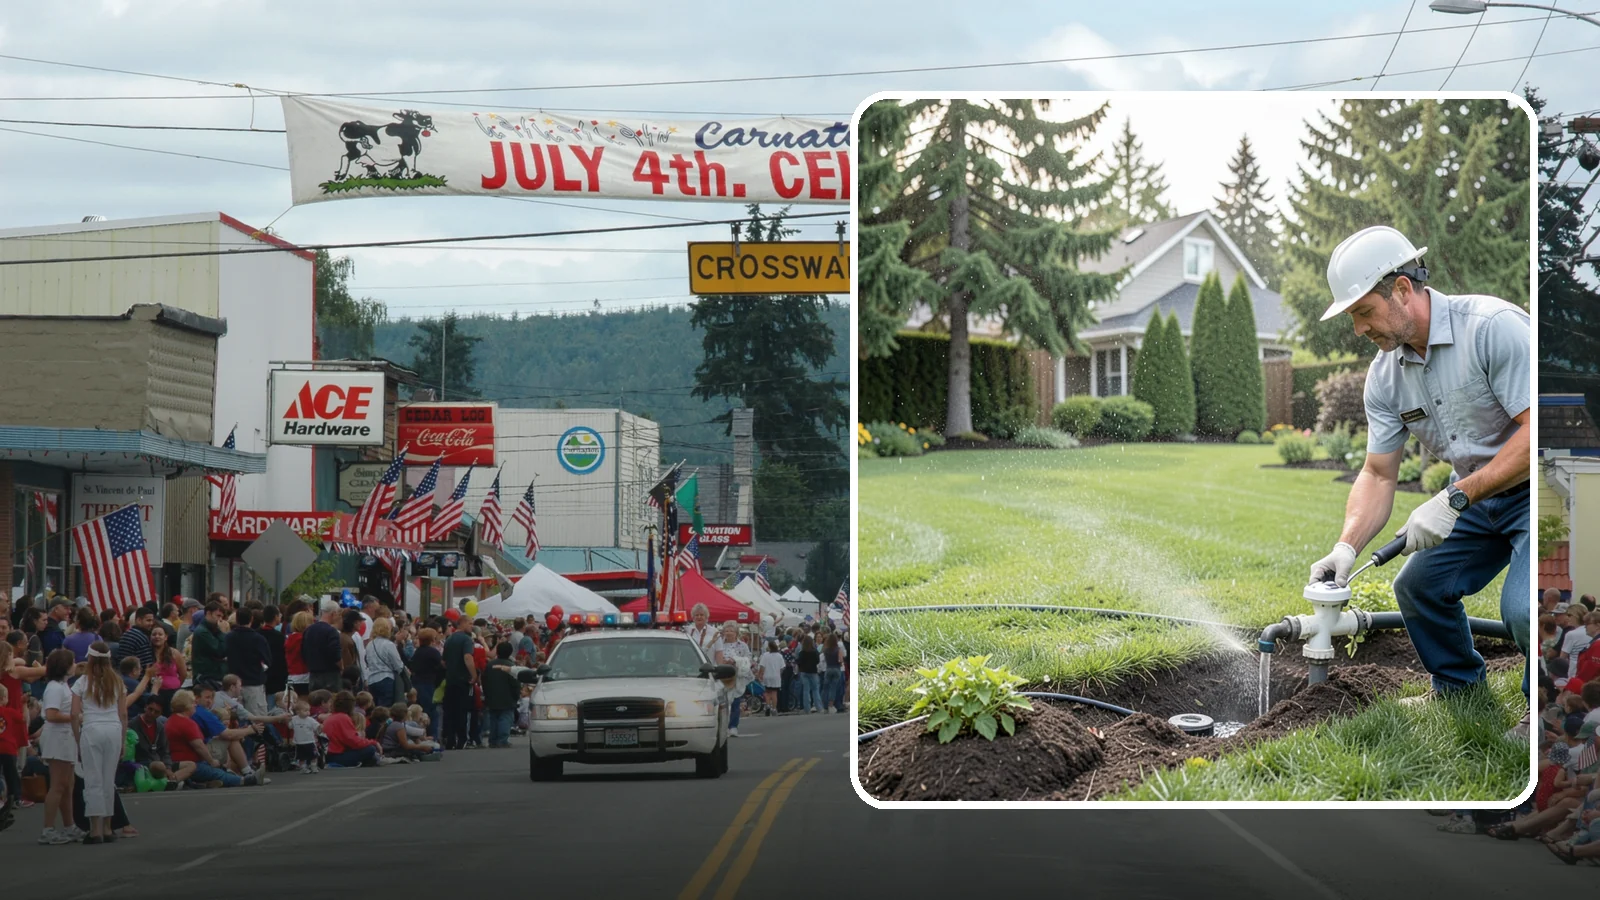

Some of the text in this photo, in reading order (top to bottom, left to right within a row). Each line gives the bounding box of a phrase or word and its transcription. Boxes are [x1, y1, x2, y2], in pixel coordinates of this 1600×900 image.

[695, 122, 850, 149] Carnat
[481, 141, 605, 192] JULY
[632, 150, 746, 197] 4th.
[697, 254, 850, 280] CROSSWA
[283, 380, 373, 420] ACE
[406, 410, 485, 422] CEDAR LOG
[283, 421, 371, 436] Hardware
[416, 428, 476, 446] Coca-Cola
[353, 467, 384, 481] Simpl
[96, 485, 124, 495] Vincent
[126, 486, 136, 495] de
[138, 486, 155, 495] Paul
[212, 516, 330, 536] HARDARE
[688, 526, 741, 535] CRNATION
[699, 535, 730, 543] GLASS
